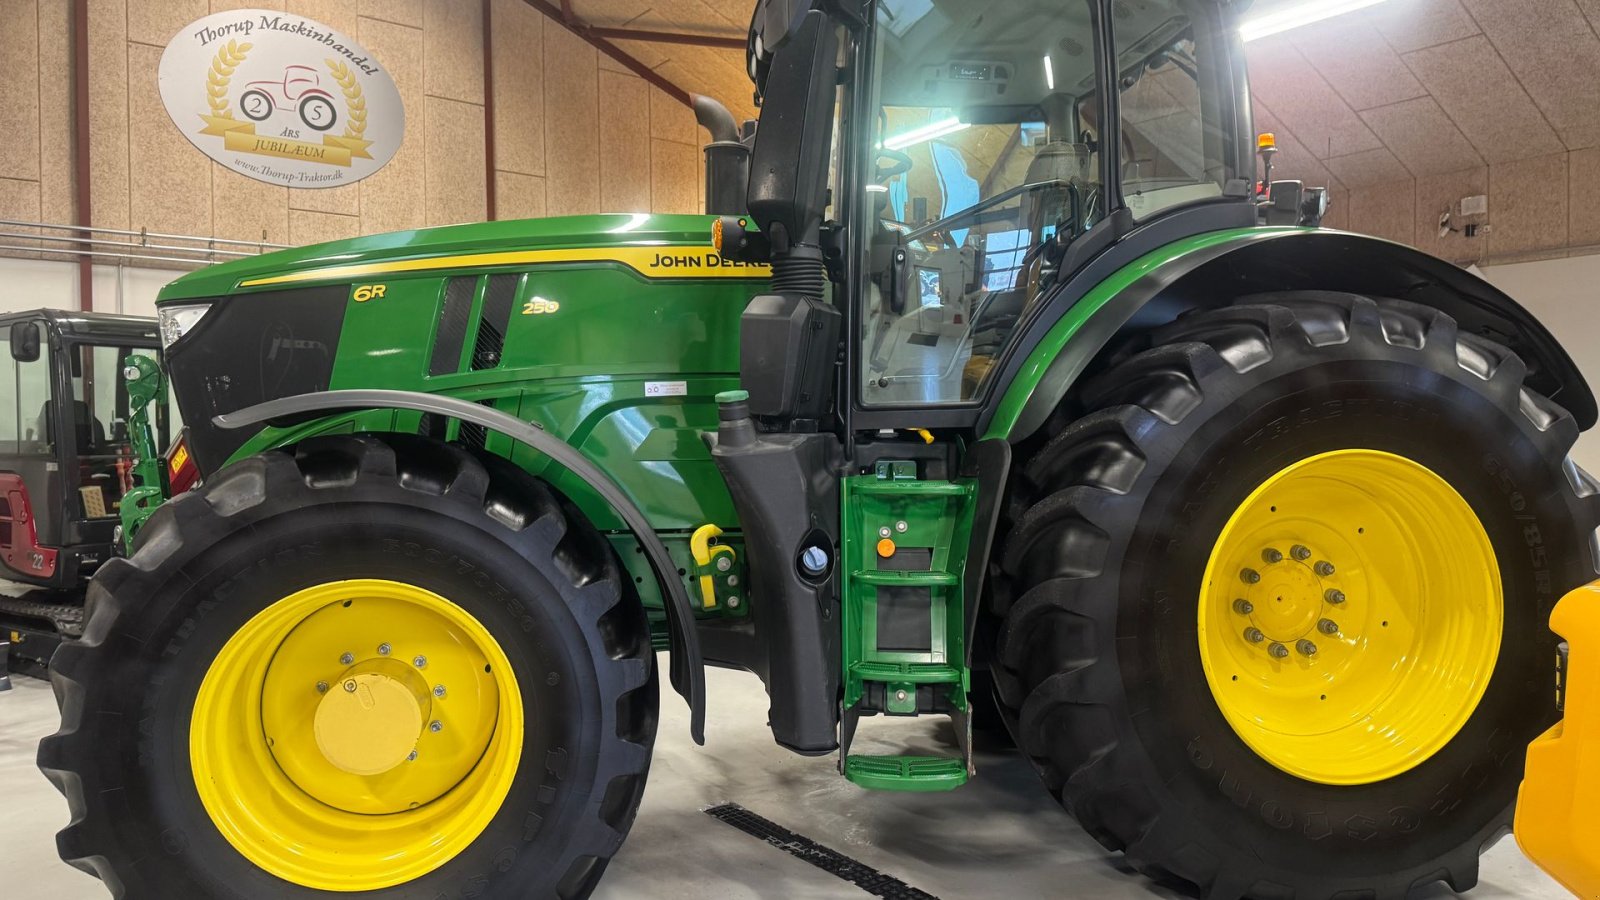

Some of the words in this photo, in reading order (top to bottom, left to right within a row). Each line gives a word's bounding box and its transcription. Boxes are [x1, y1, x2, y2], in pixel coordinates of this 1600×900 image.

[195, 18, 254, 47] Thorup
[258, 15, 379, 76] Maskinhandel
[249, 97, 262, 113] 2
[311, 105, 323, 121] 5
[280, 126, 300, 139] ÅRS
[252, 139, 326, 159] JUBILÆUM
[234, 158, 343, 183] www.Thorup-Traktor.dk
[650, 253, 702, 268] JOHN
[353, 285, 387, 302] 6R
[522, 300, 560, 315] 250
[32, 553, 44, 570] 22
